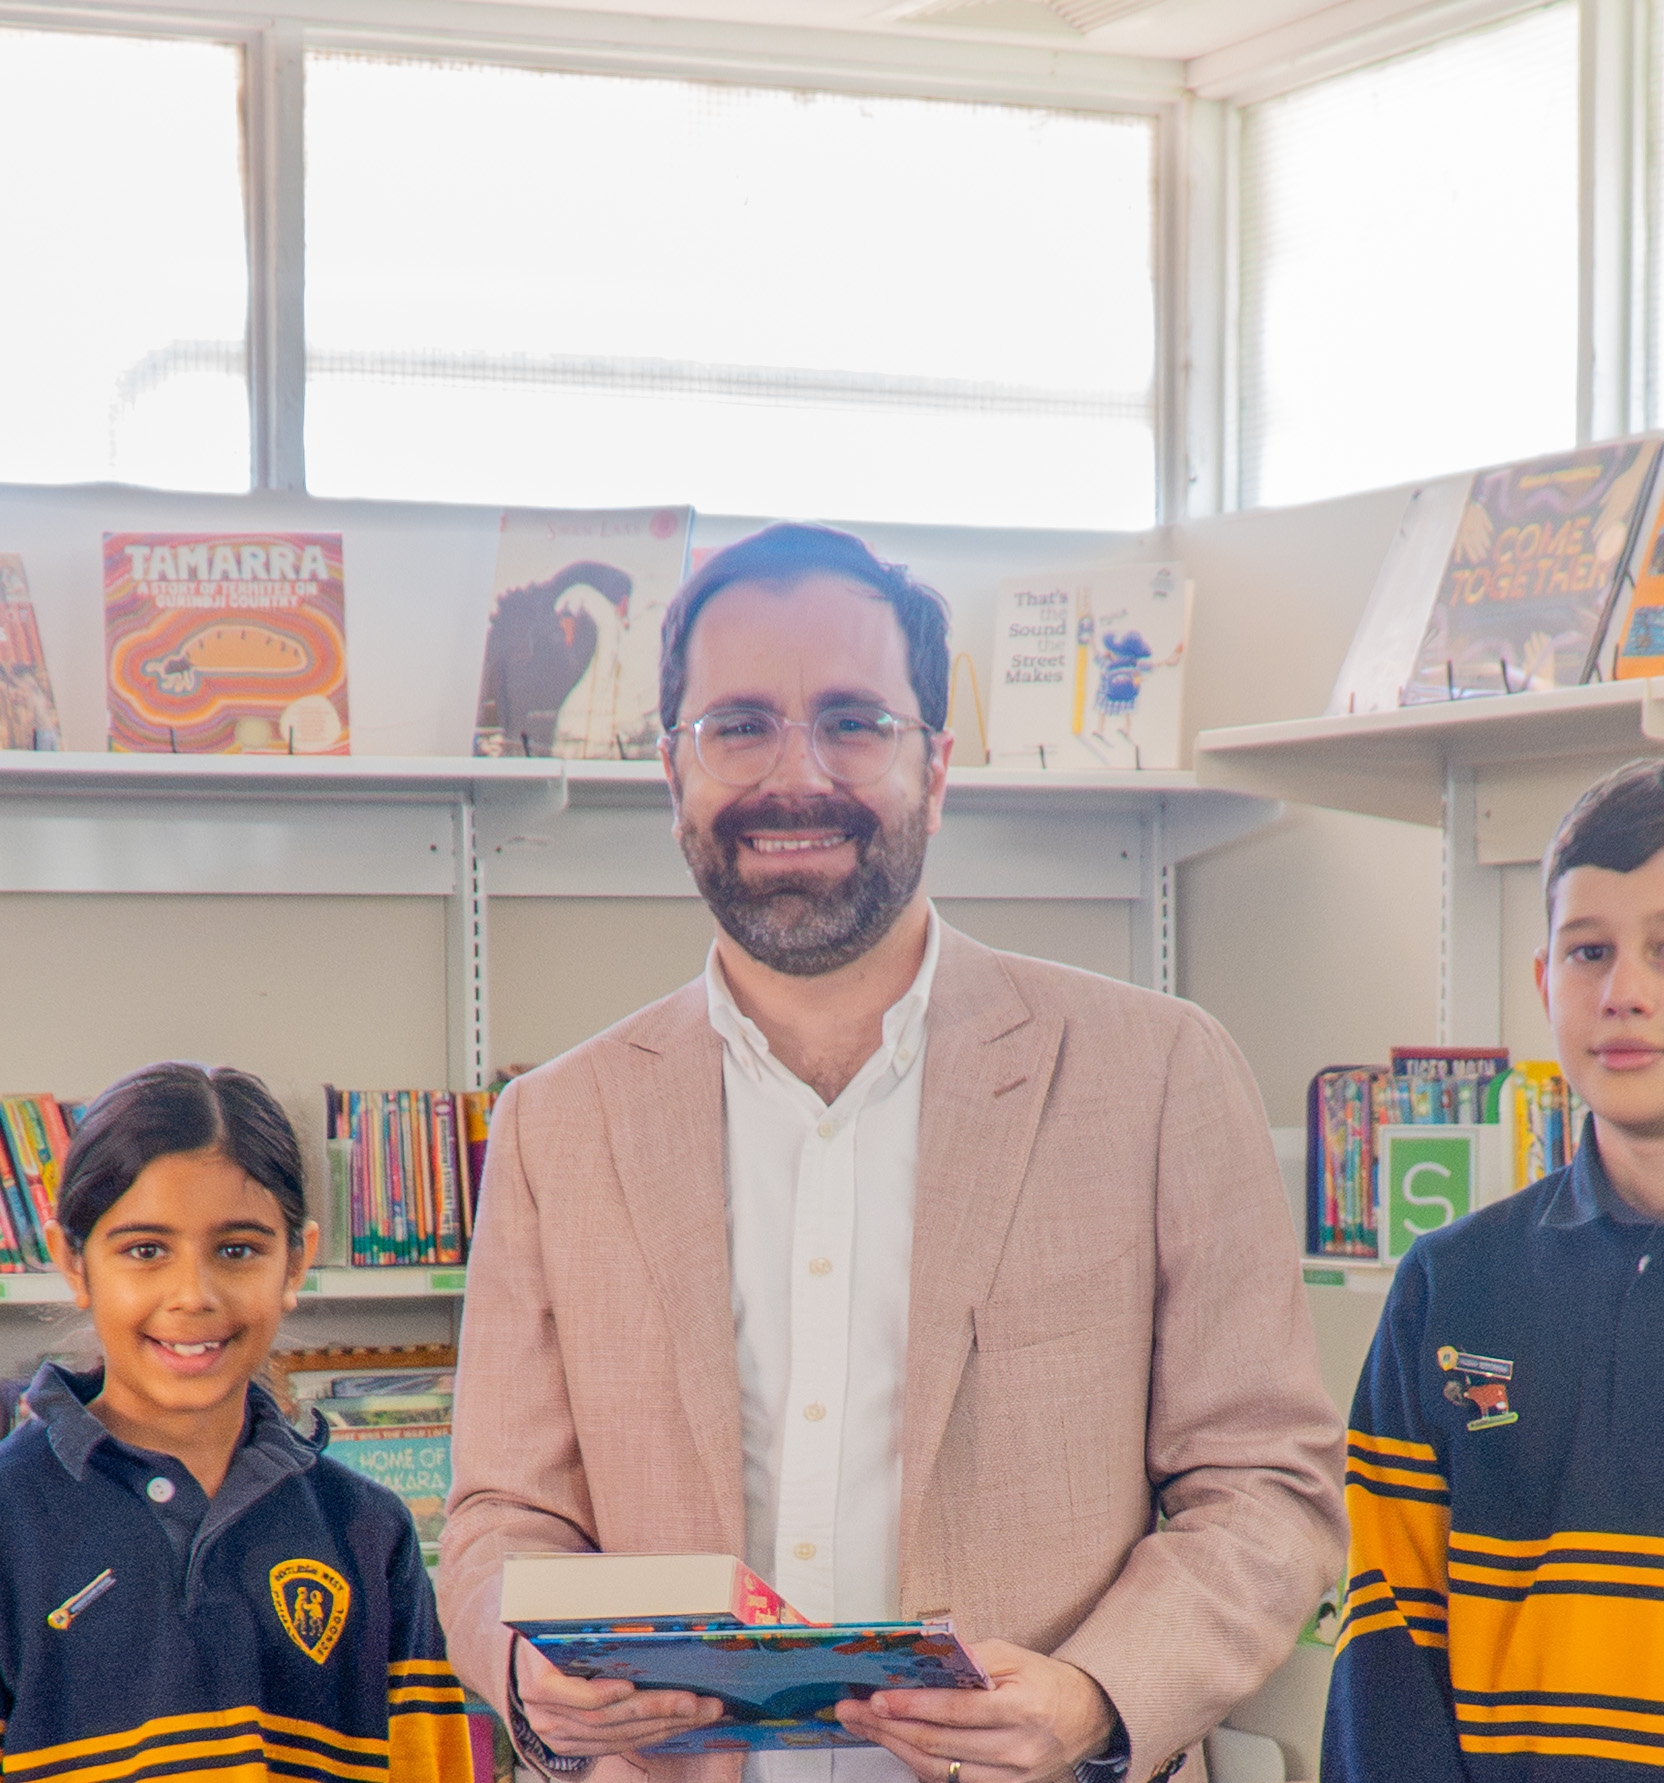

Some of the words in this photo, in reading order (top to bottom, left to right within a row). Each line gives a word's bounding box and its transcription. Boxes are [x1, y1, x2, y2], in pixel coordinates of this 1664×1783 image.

[1491, 516, 1592, 564] COME
[124, 545, 329, 580] TAMARRA
[1448, 554, 1608, 607] TOGETHER
[1014, 589, 1069, 607] That's
[1008, 620, 1067, 638] Sound
[1011, 653, 1066, 669] Street
[1004, 669, 1065, 685] Makes
[1402, 1161, 1455, 1238] S
[359, 1449, 415, 1472] HOME
[420, 1448, 446, 1468] OF
